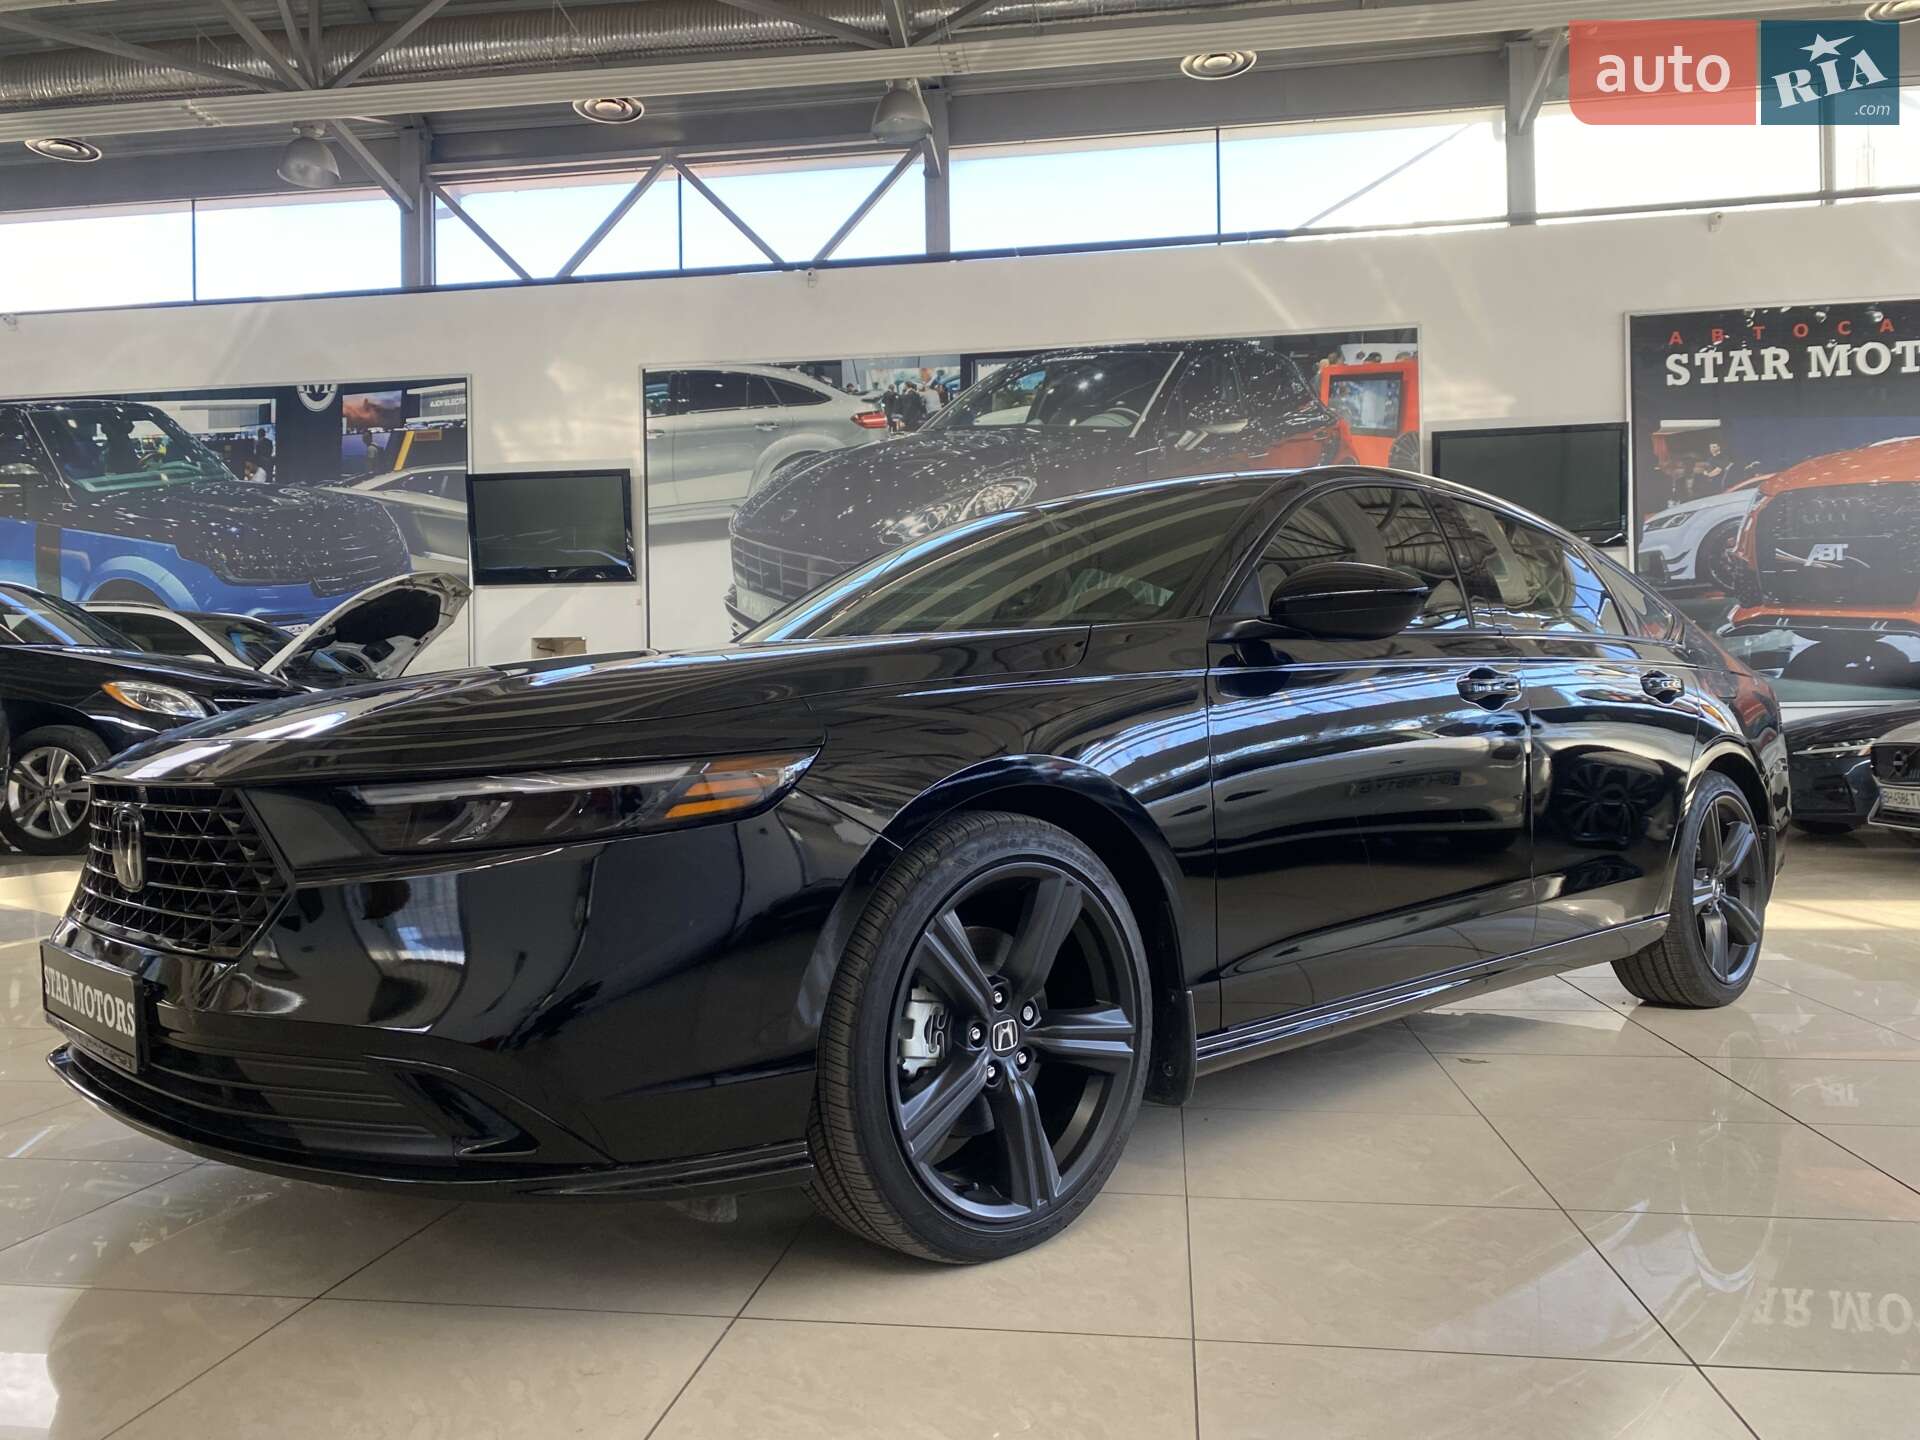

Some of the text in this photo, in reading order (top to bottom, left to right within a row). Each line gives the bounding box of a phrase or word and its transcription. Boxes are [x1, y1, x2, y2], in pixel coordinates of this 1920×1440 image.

[1666, 346, 1794, 386] STAR
[1804, 543, 1848, 566] ABT
[44, 965, 135, 1037] STAR MOTORS
